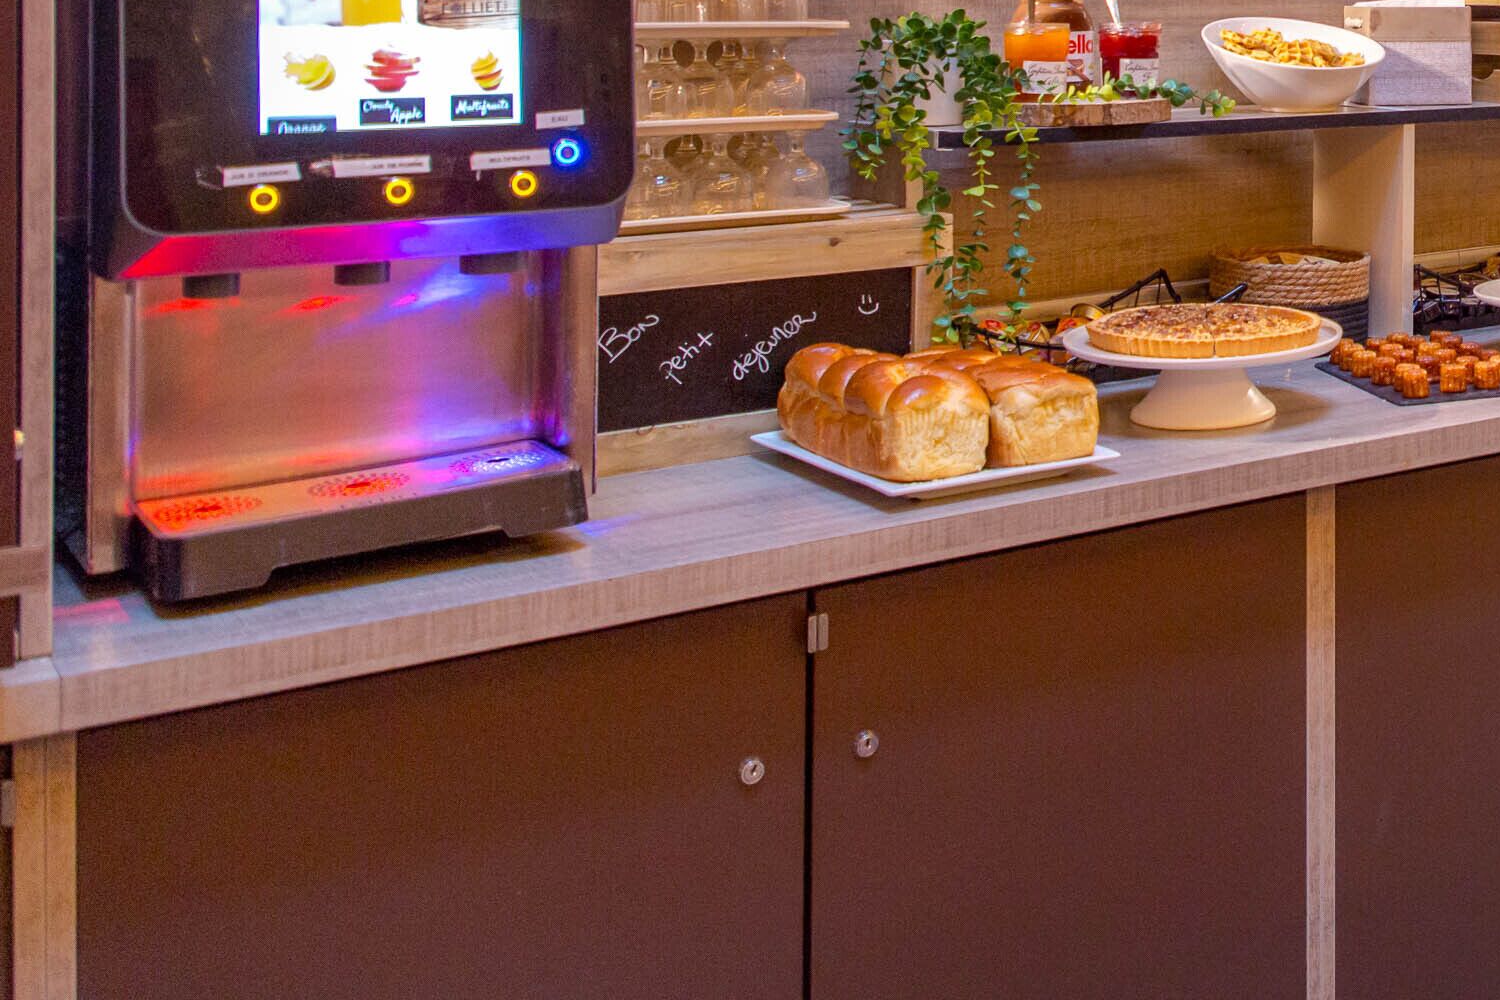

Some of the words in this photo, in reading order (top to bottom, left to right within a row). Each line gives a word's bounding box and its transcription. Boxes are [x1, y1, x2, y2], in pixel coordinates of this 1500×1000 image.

[1067, 33, 1094, 55] ella
[390, 104, 424, 124] Apple
[597, 314, 660, 364] Bon
